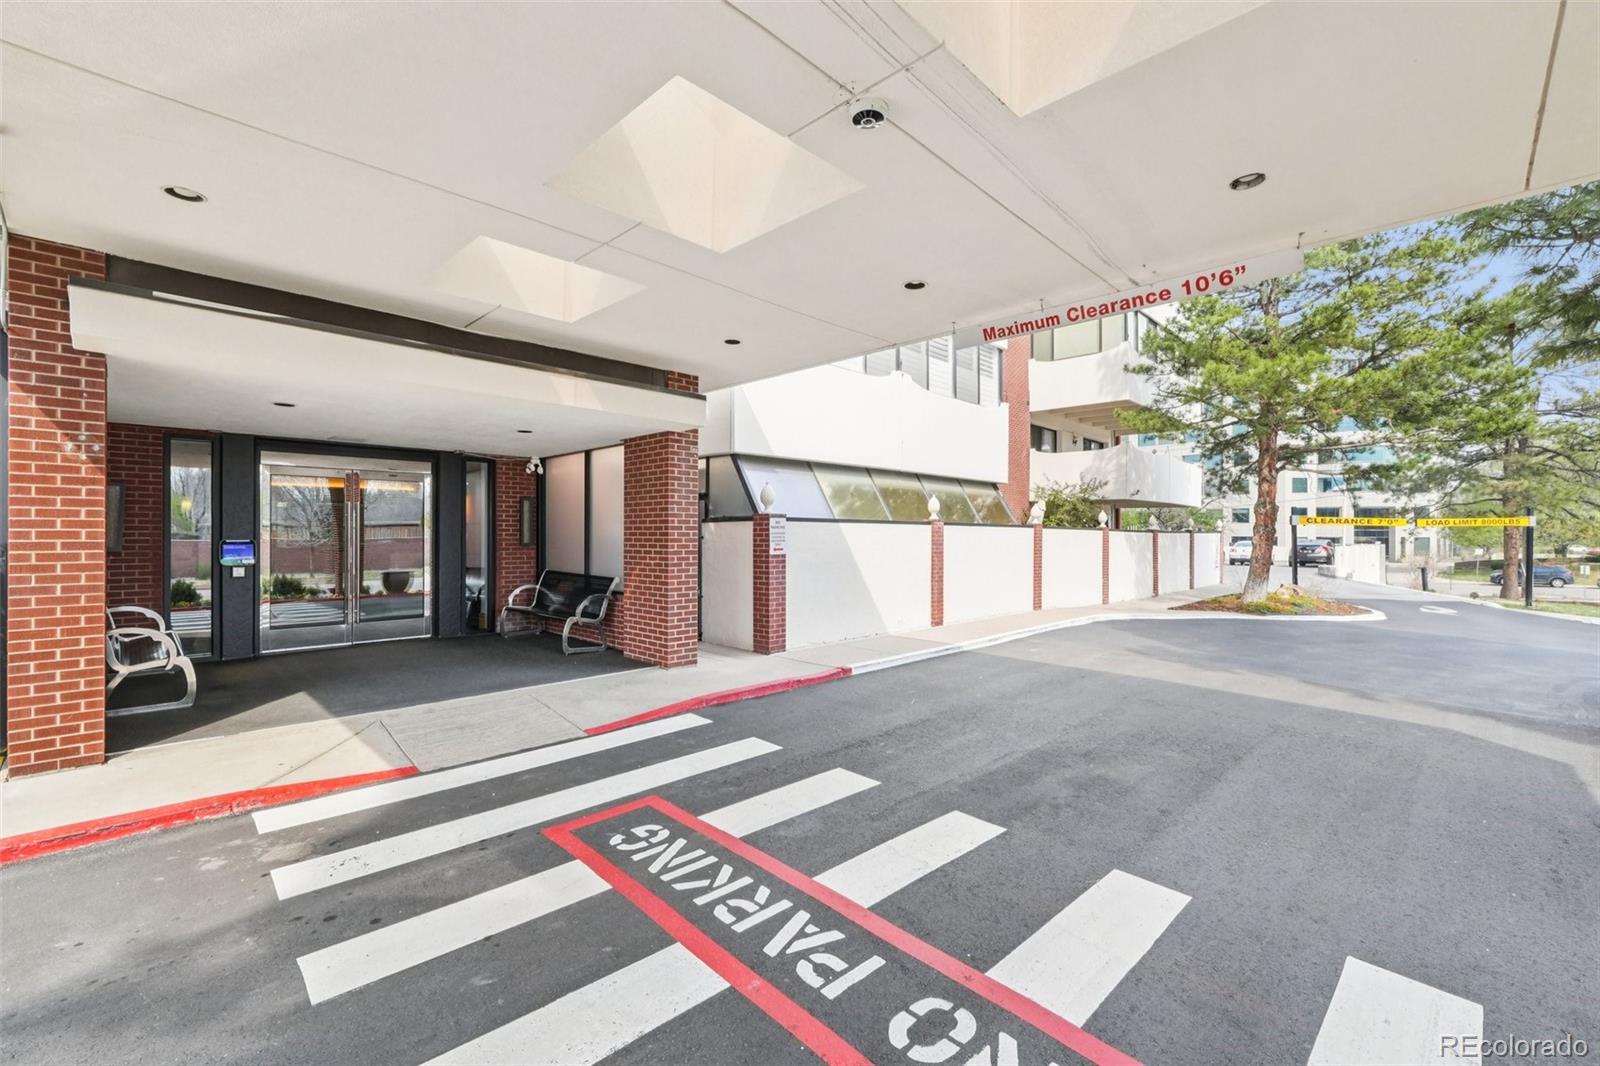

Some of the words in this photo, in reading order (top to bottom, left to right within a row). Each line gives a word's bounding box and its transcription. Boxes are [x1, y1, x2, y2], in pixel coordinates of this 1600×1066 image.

[983, 314, 1060, 341] Maximum
[1066, 288, 1172, 322] Clearance
[1306, 517, 1373, 525] CLEARANCE
[608, 824, 887, 999] PARKING
